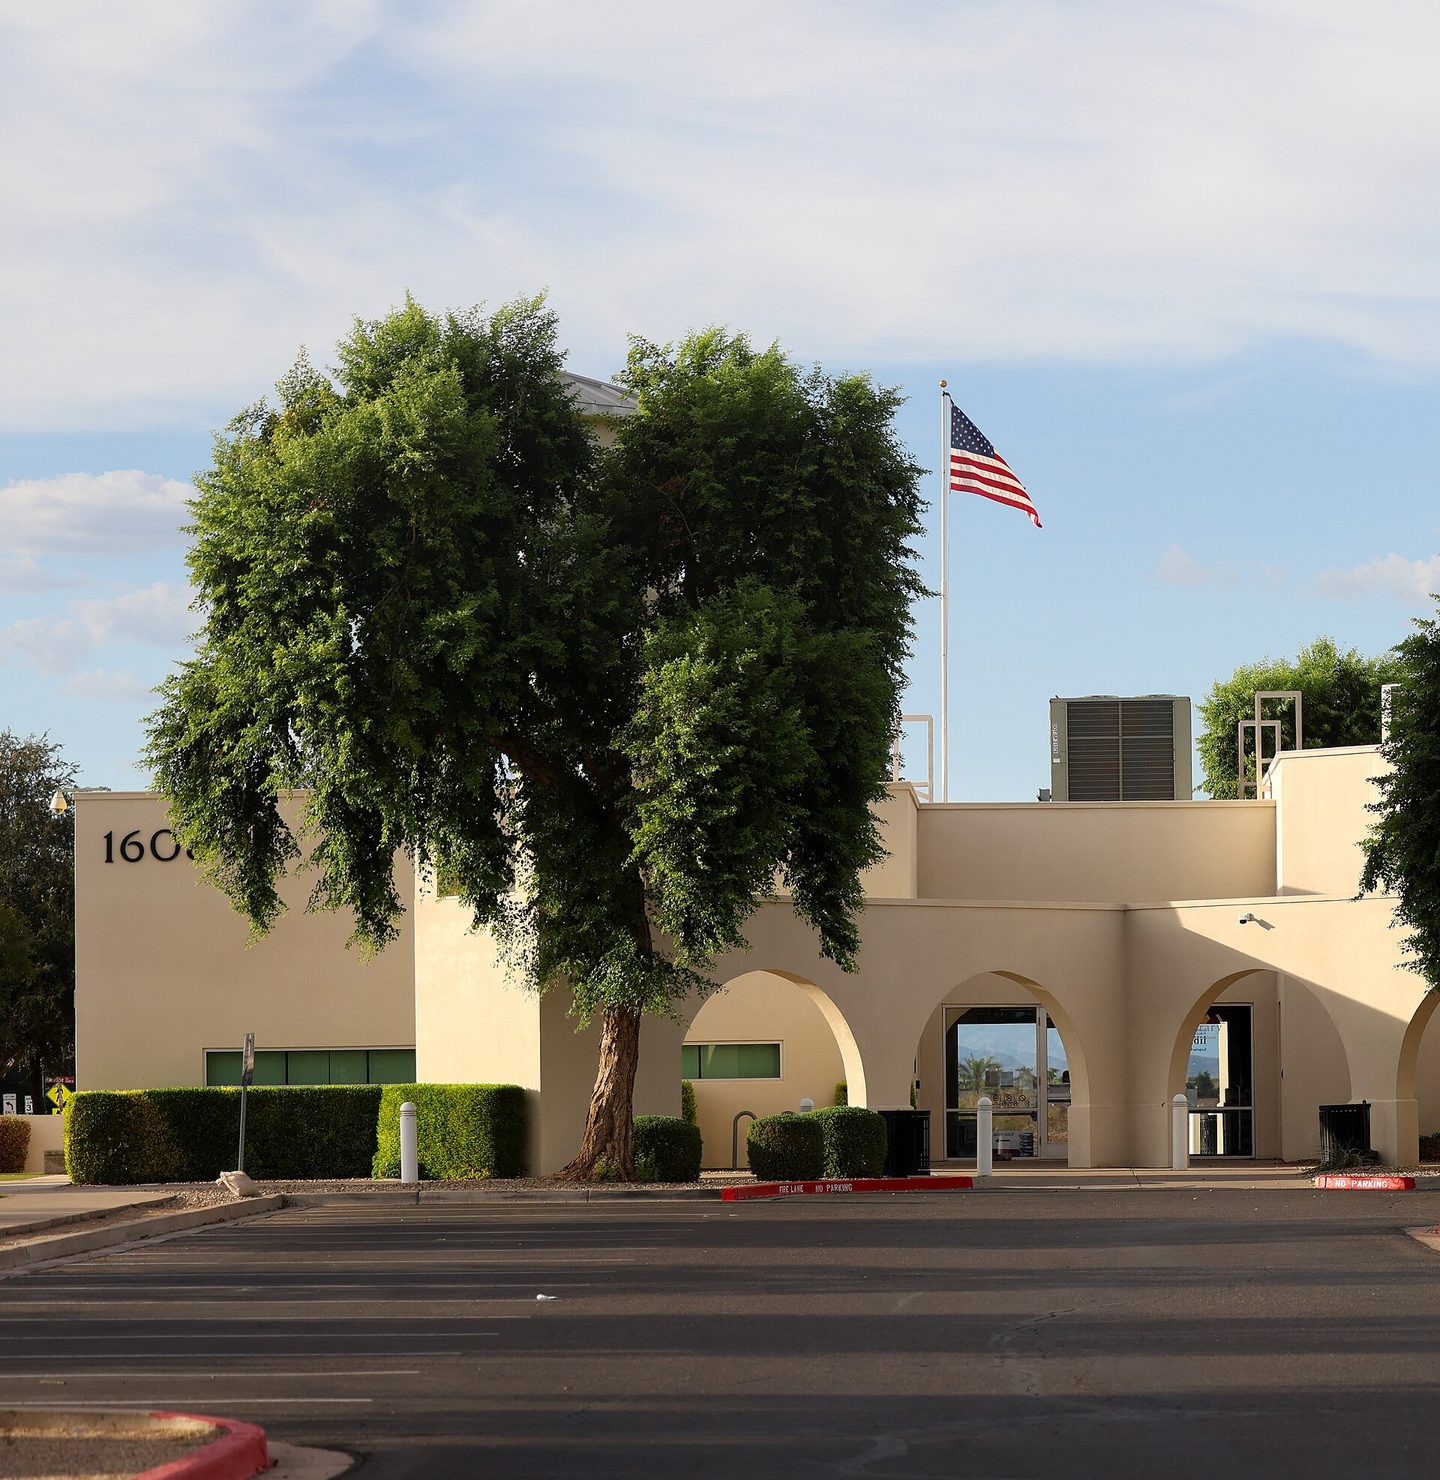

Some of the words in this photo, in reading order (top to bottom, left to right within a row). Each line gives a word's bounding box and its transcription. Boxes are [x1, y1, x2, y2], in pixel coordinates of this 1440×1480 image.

[779, 1185, 789, 1194] FIRE
[790, 1184, 804, 1193] LANE
[815, 1184, 824, 1193] NO
[826, 1183, 853, 1193] PARKING
[1335, 1180, 1346, 1188] NO
[1351, 1180, 1388, 1188] PARKING
